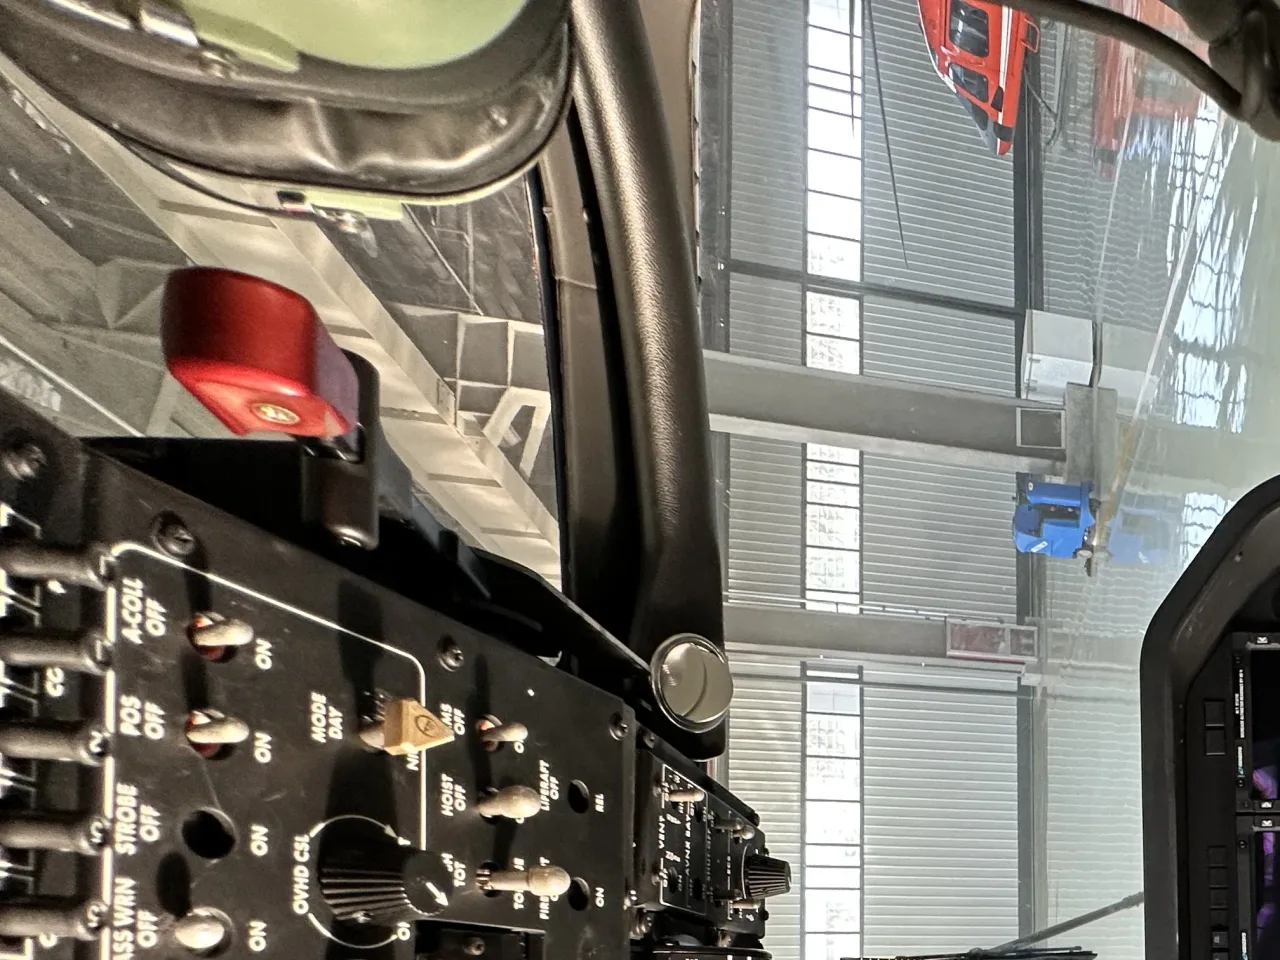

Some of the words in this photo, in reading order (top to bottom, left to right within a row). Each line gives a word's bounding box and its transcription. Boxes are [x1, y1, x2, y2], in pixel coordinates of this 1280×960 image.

[122, 577, 145, 643] A-COLL
[146, 598, 168, 636] OFF
[255, 639, 273, 670] ON
[121, 695, 142, 735] POS
[145, 702, 166, 739] OFF
[311, 690, 327, 742] MODE
[329, 705, 343, 739] DAY
[454, 708, 465, 735] OFF
[254, 732, 272, 763] ON
[442, 774, 453, 816] HOIST
[455, 785, 466, 811] OFF
[540, 760, 550, 811] LIFERAFT
[550, 776, 559, 800] OFF
[595, 793, 604, 813] REL
[116, 783, 137, 855] STROBE
[140, 804, 161, 842] OFF
[251, 825, 268, 856] ON
[295, 834, 310, 863] CSL
[293, 865, 309, 915] OVHD
[455, 861, 466, 887] TOT
[115, 878, 136, 926] WRN
[595, 887, 605, 907] ON
[138, 910, 157, 948] OFF
[249, 921, 267, 952] ON
